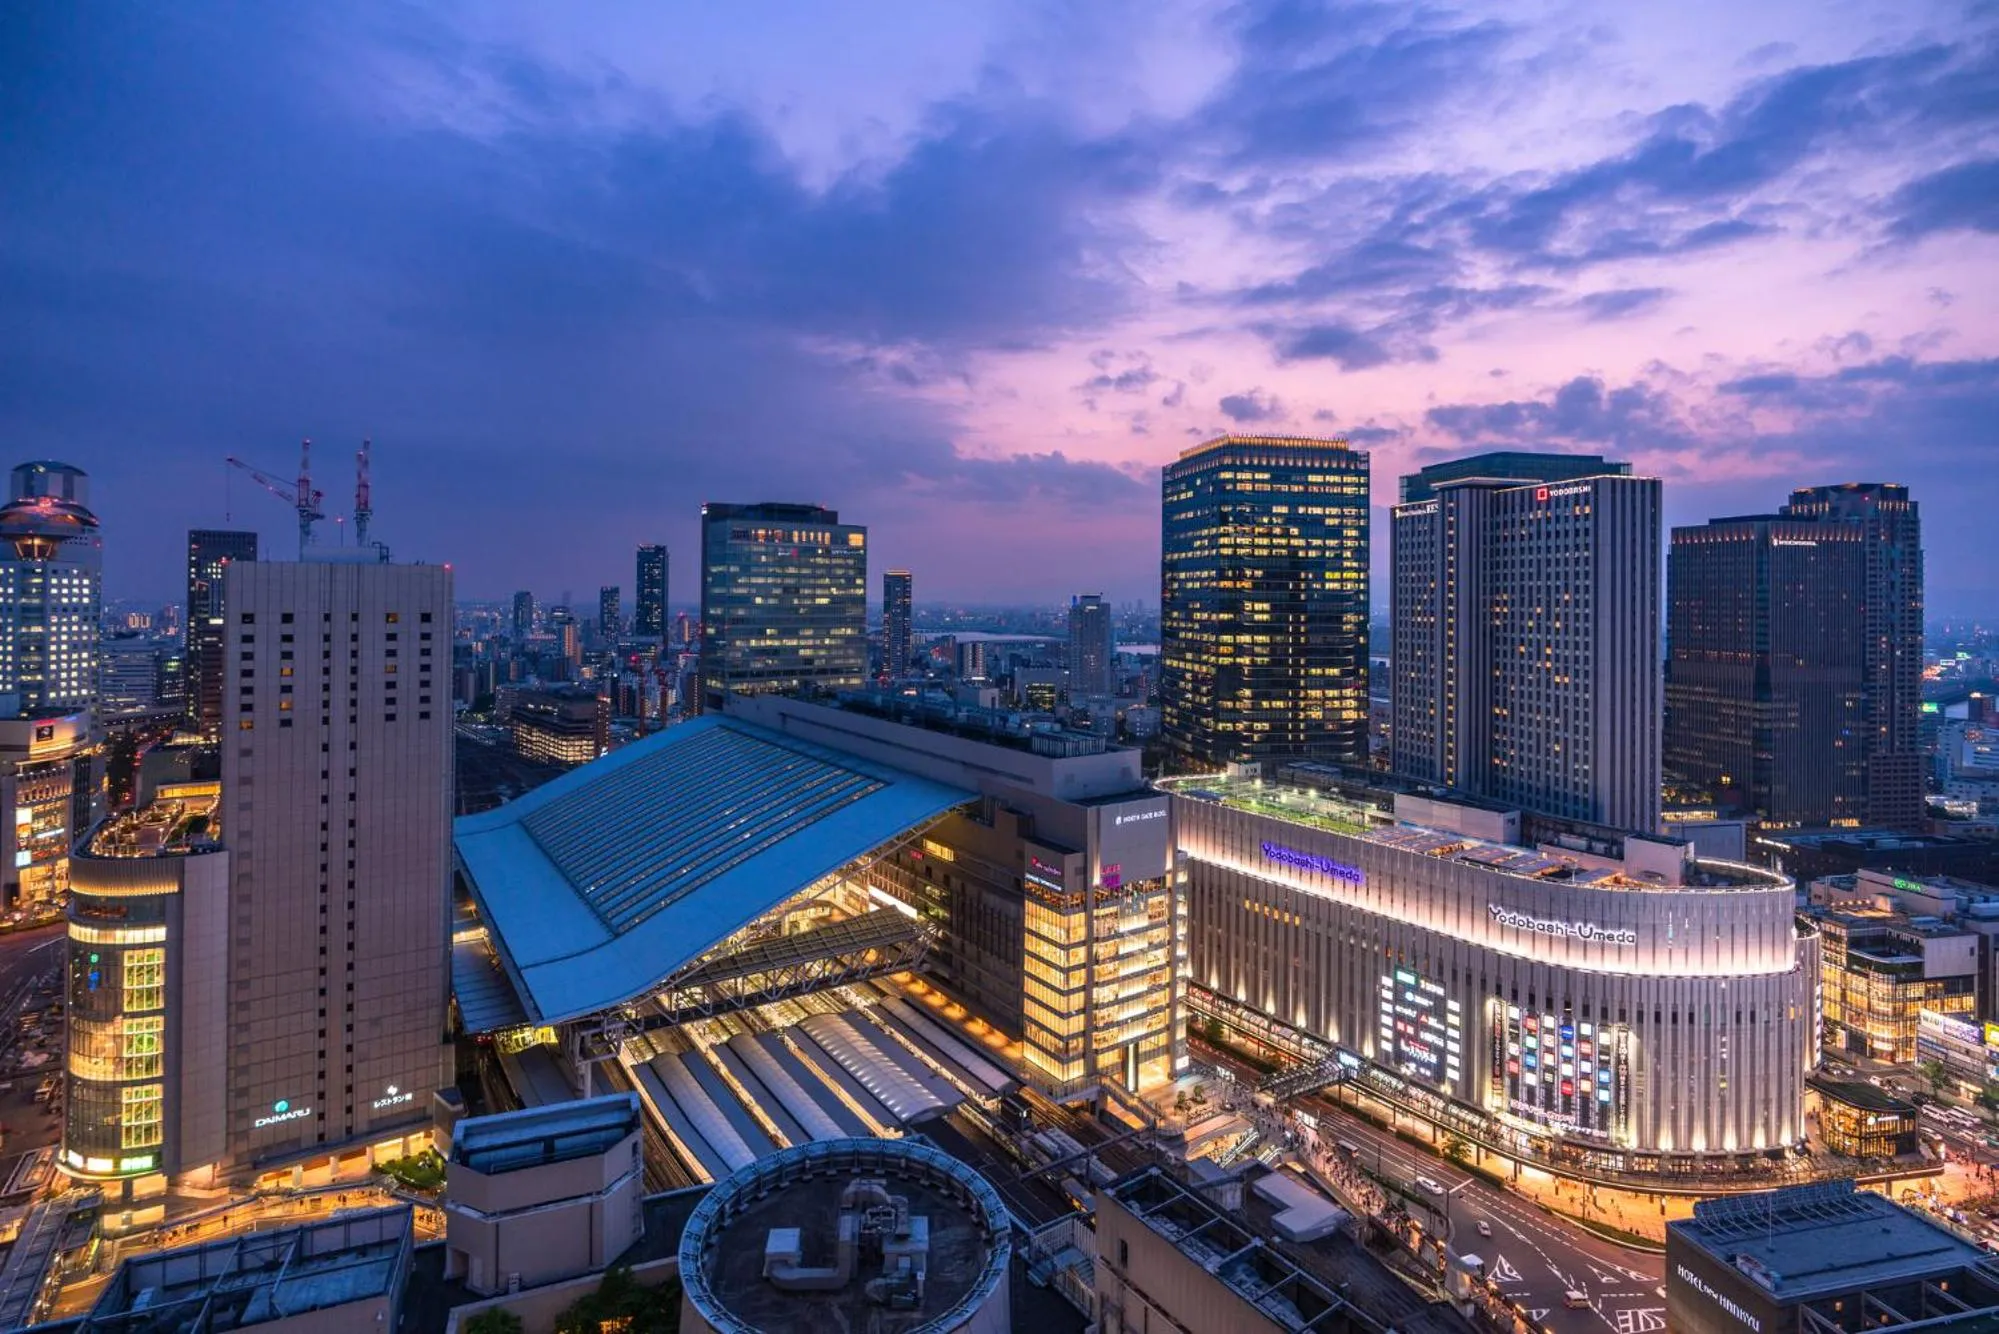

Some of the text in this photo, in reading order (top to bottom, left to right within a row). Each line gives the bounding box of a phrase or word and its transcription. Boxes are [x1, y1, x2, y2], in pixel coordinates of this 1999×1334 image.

[1549, 485, 1592, 496] YODOBASHI
[1262, 843, 1361, 882] Yodobashi-Umeda
[1489, 904, 1636, 943] Yodobashi-Umeda
[255, 1107, 311, 1128] DAIMARU
[1677, 1263, 1704, 1293] HOTEL
[1719, 1293, 1760, 1333] HANKYU
